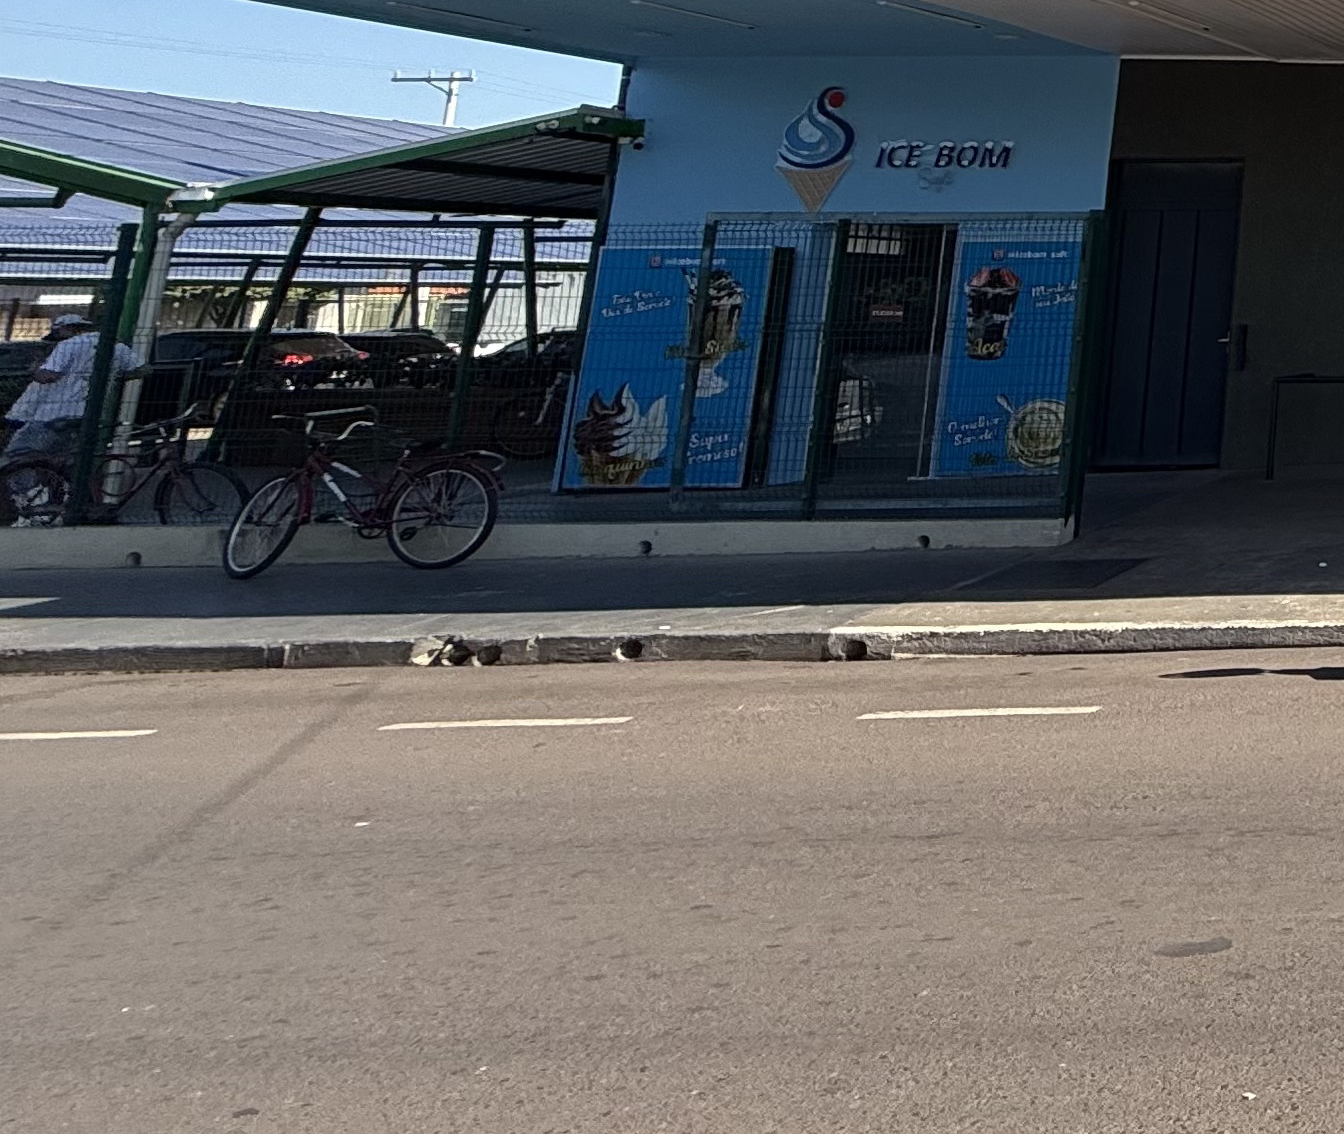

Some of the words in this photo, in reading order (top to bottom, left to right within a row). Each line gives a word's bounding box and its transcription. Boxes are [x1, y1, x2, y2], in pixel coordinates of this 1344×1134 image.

[875, 139, 924, 169] ICE
[934, 140, 1015, 169] BOM
[686, 441, 744, 465] remoso!
[688, 432, 731, 451] Super
